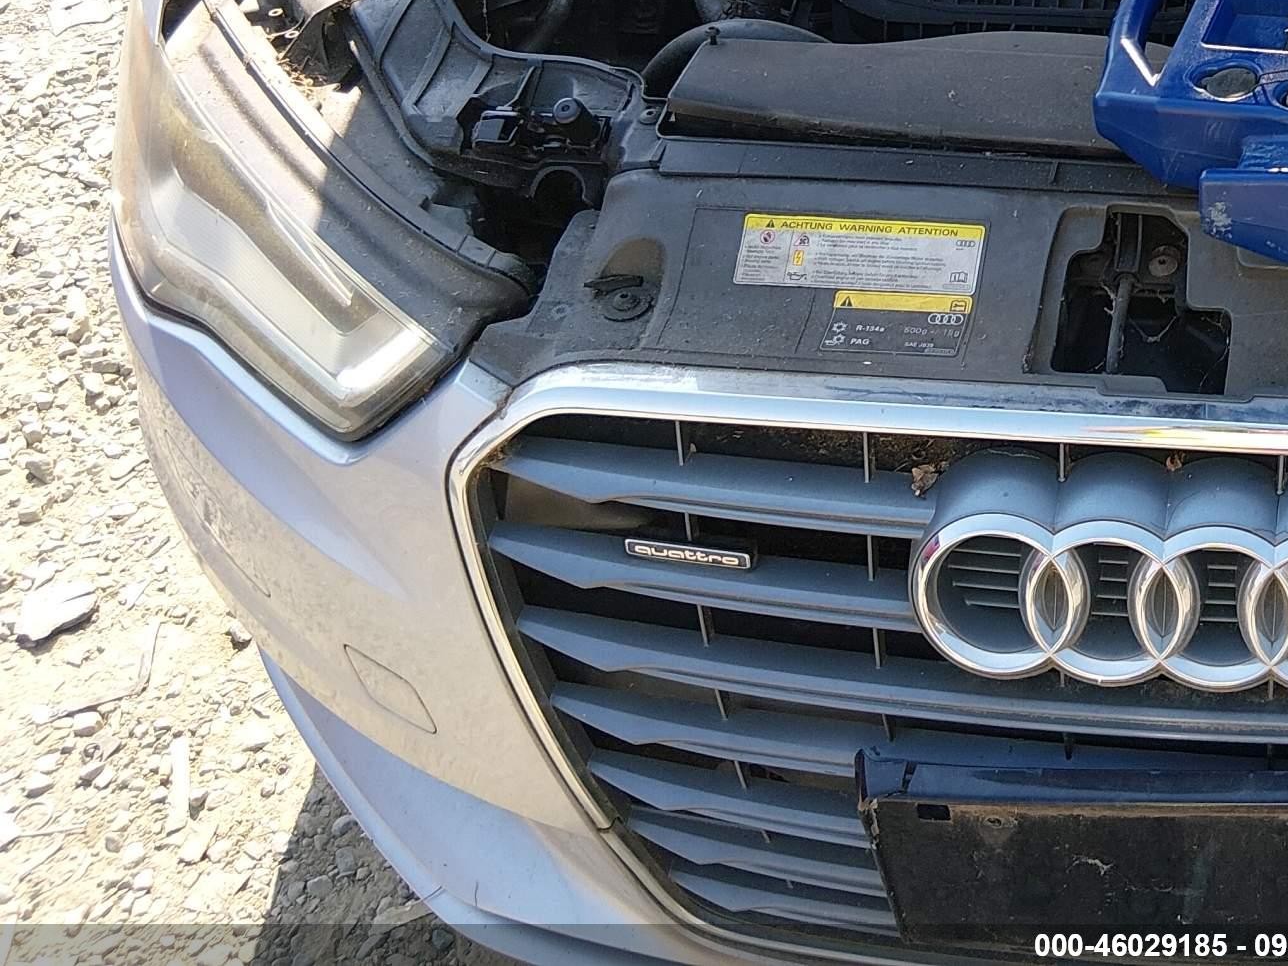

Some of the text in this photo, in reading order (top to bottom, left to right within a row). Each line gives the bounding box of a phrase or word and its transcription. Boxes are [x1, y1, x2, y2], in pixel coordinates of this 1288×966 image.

[781, 221, 958, 237] ACHTUNG WARNING ATTENTION
[850, 338, 870, 346] PAG
[634, 545, 739, 565] quattro
